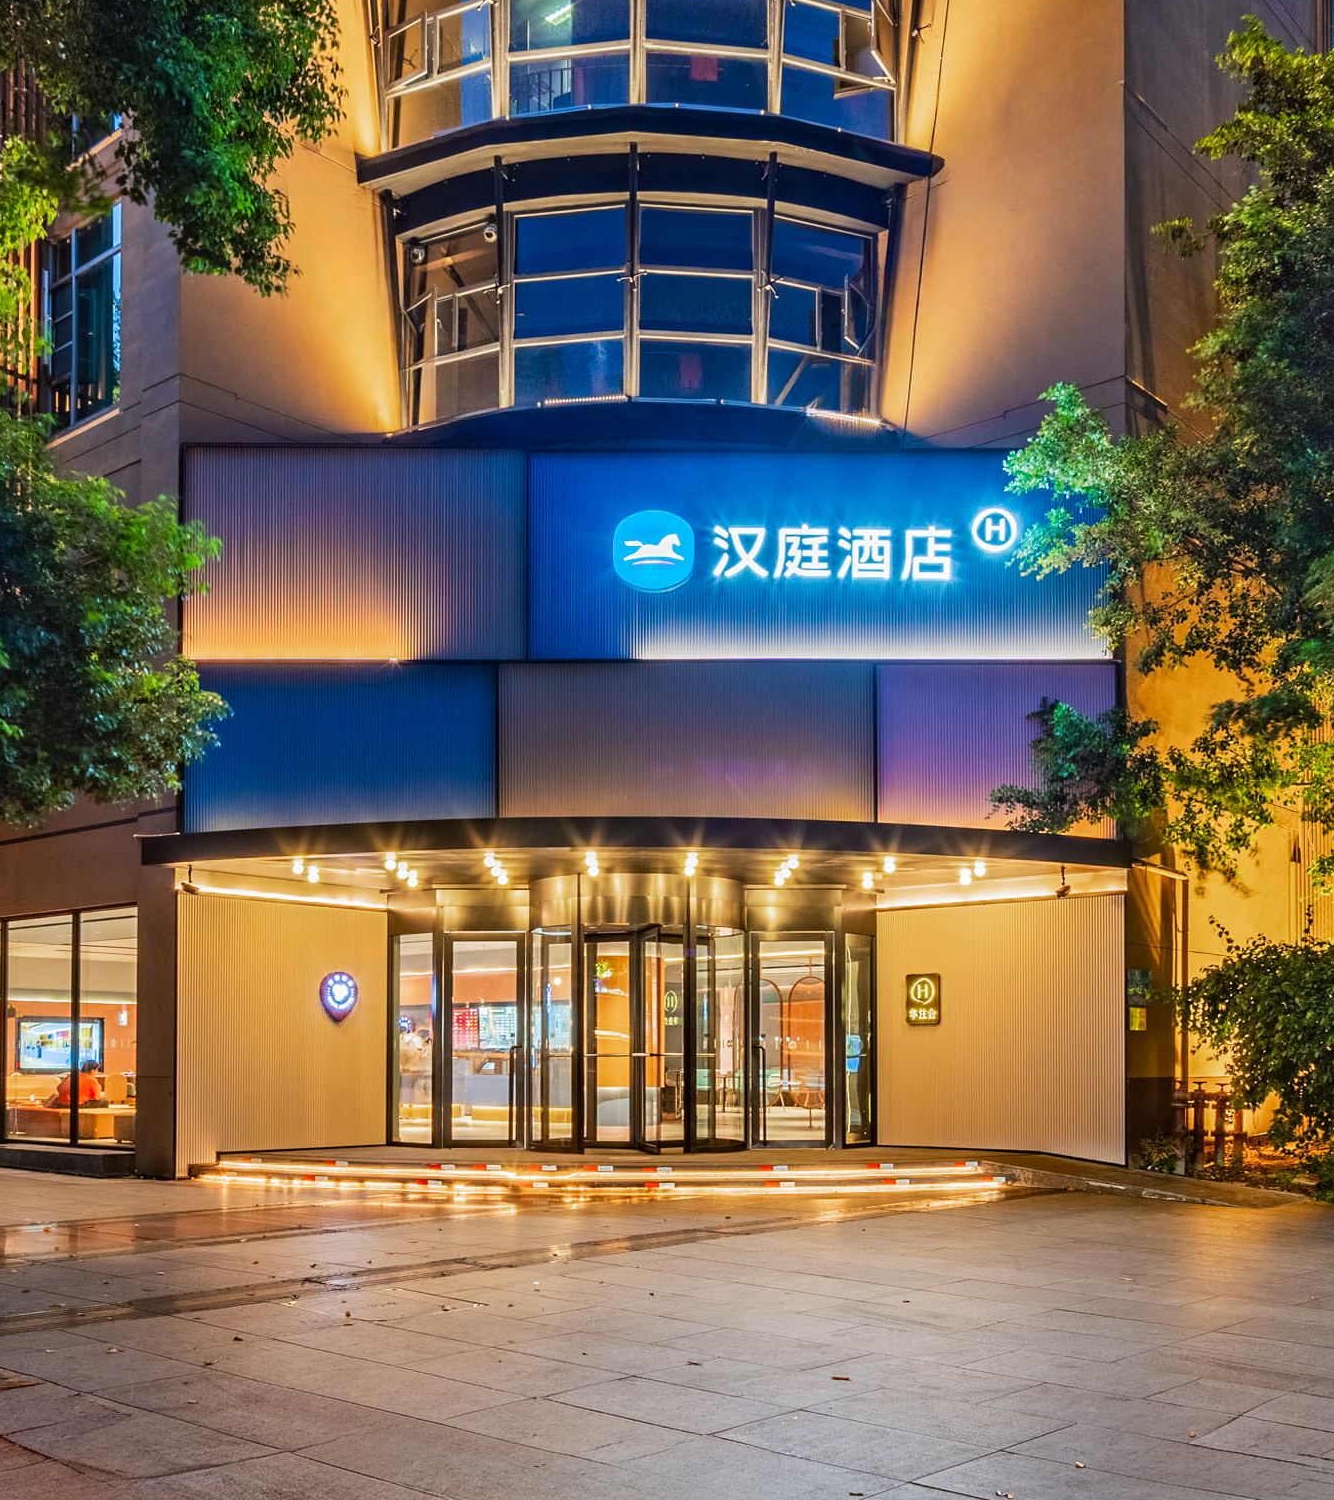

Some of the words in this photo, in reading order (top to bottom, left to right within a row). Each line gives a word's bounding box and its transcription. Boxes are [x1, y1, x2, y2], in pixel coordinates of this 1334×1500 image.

[712, 523, 953, 581] 汉庭酒店
[909, 1008, 937, 1020] 华住会
